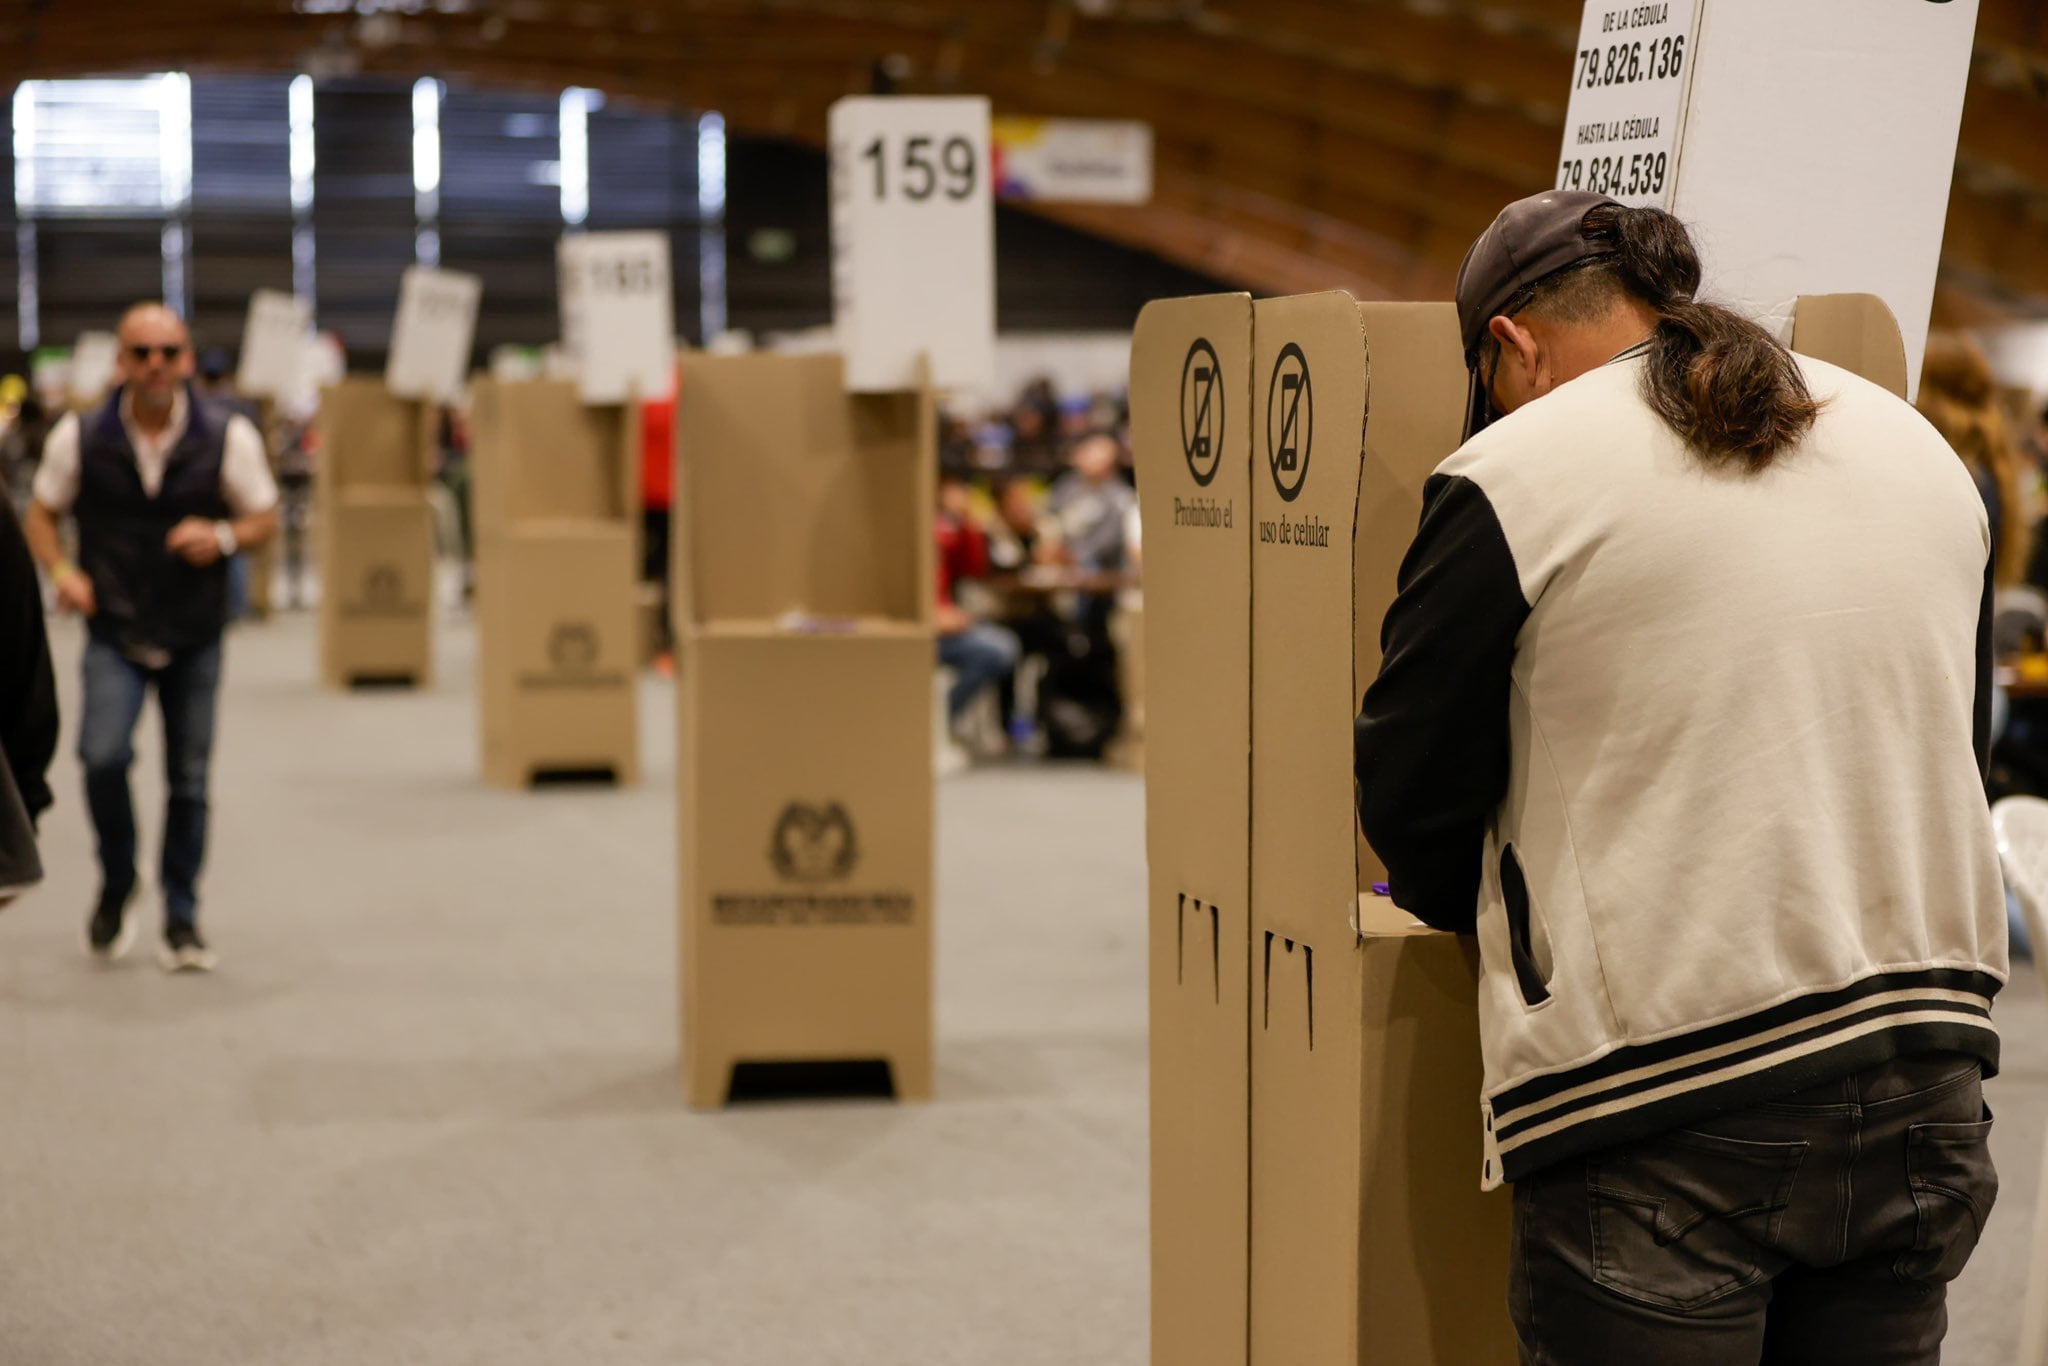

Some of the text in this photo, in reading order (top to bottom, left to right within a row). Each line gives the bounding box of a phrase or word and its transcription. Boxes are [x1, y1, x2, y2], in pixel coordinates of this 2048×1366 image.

[1602, 2, 1668, 33] DE LA CÉDULA
[1577, 35, 1684, 90] 79.826.136
[1577, 115, 1660, 145] HASTA LA CÉDULA
[861, 134, 977, 202] 159
[1562, 151, 1667, 196] 79834.539
[1174, 496, 1233, 529] Prohibido el
[1259, 513, 1330, 548] uso de celular
